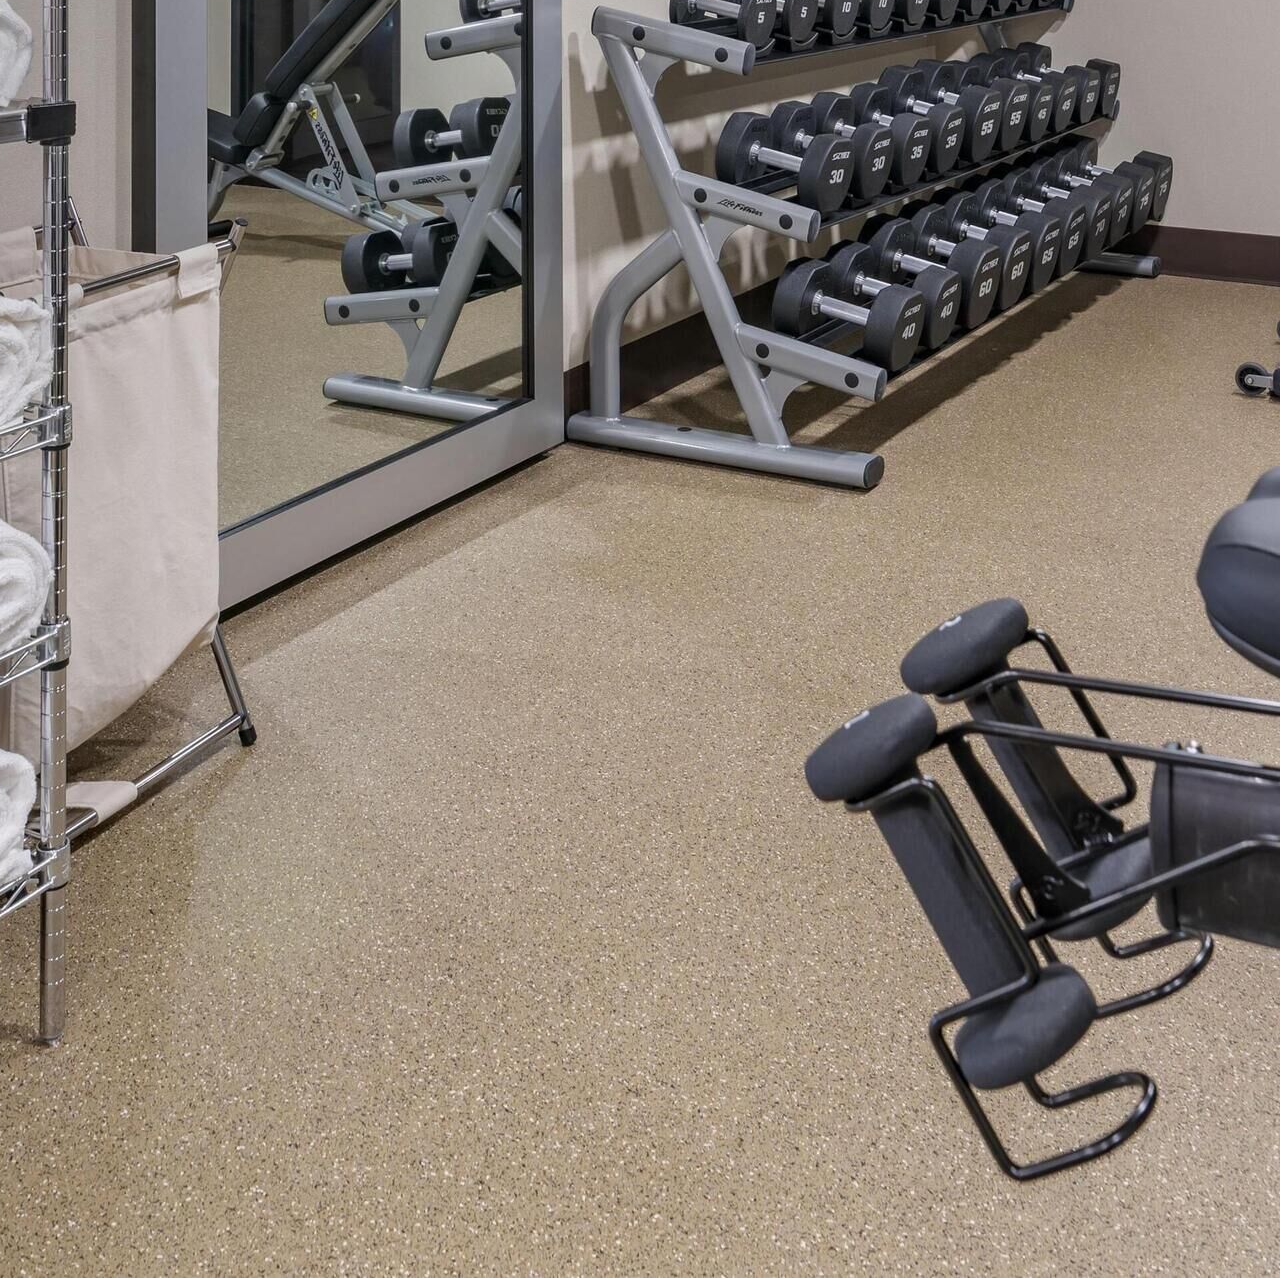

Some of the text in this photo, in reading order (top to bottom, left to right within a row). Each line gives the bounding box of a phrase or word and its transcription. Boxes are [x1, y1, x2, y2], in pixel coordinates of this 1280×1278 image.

[801, 6, 808, 18] 5
[842, 1, 852, 13] 10
[758, 11, 765, 23] 5
[1062, 99, 1072, 112] 45
[1086, 92, 1095, 103] 50
[1010, 111, 1022, 126] 55
[1037, 108, 1047, 120] 45
[980, 119, 995, 136] 55
[945, 134, 957, 149] 35
[910, 145, 924, 159] 35
[872, 156, 885, 172] 30
[829, 169, 844, 185] 30
[1159, 181, 1168, 197] 75
[1139, 193, 1150, 210] 75
[1118, 204, 1127, 223] 70
[1095, 218, 1106, 237] 70
[1068, 231, 1080, 250] 65
[1042, 247, 1055, 264] 65
[1011, 261, 1024, 281] 60
[979, 278, 993, 298] 60
[940, 301, 953, 319] 40
[902, 322, 916, 340] 40
